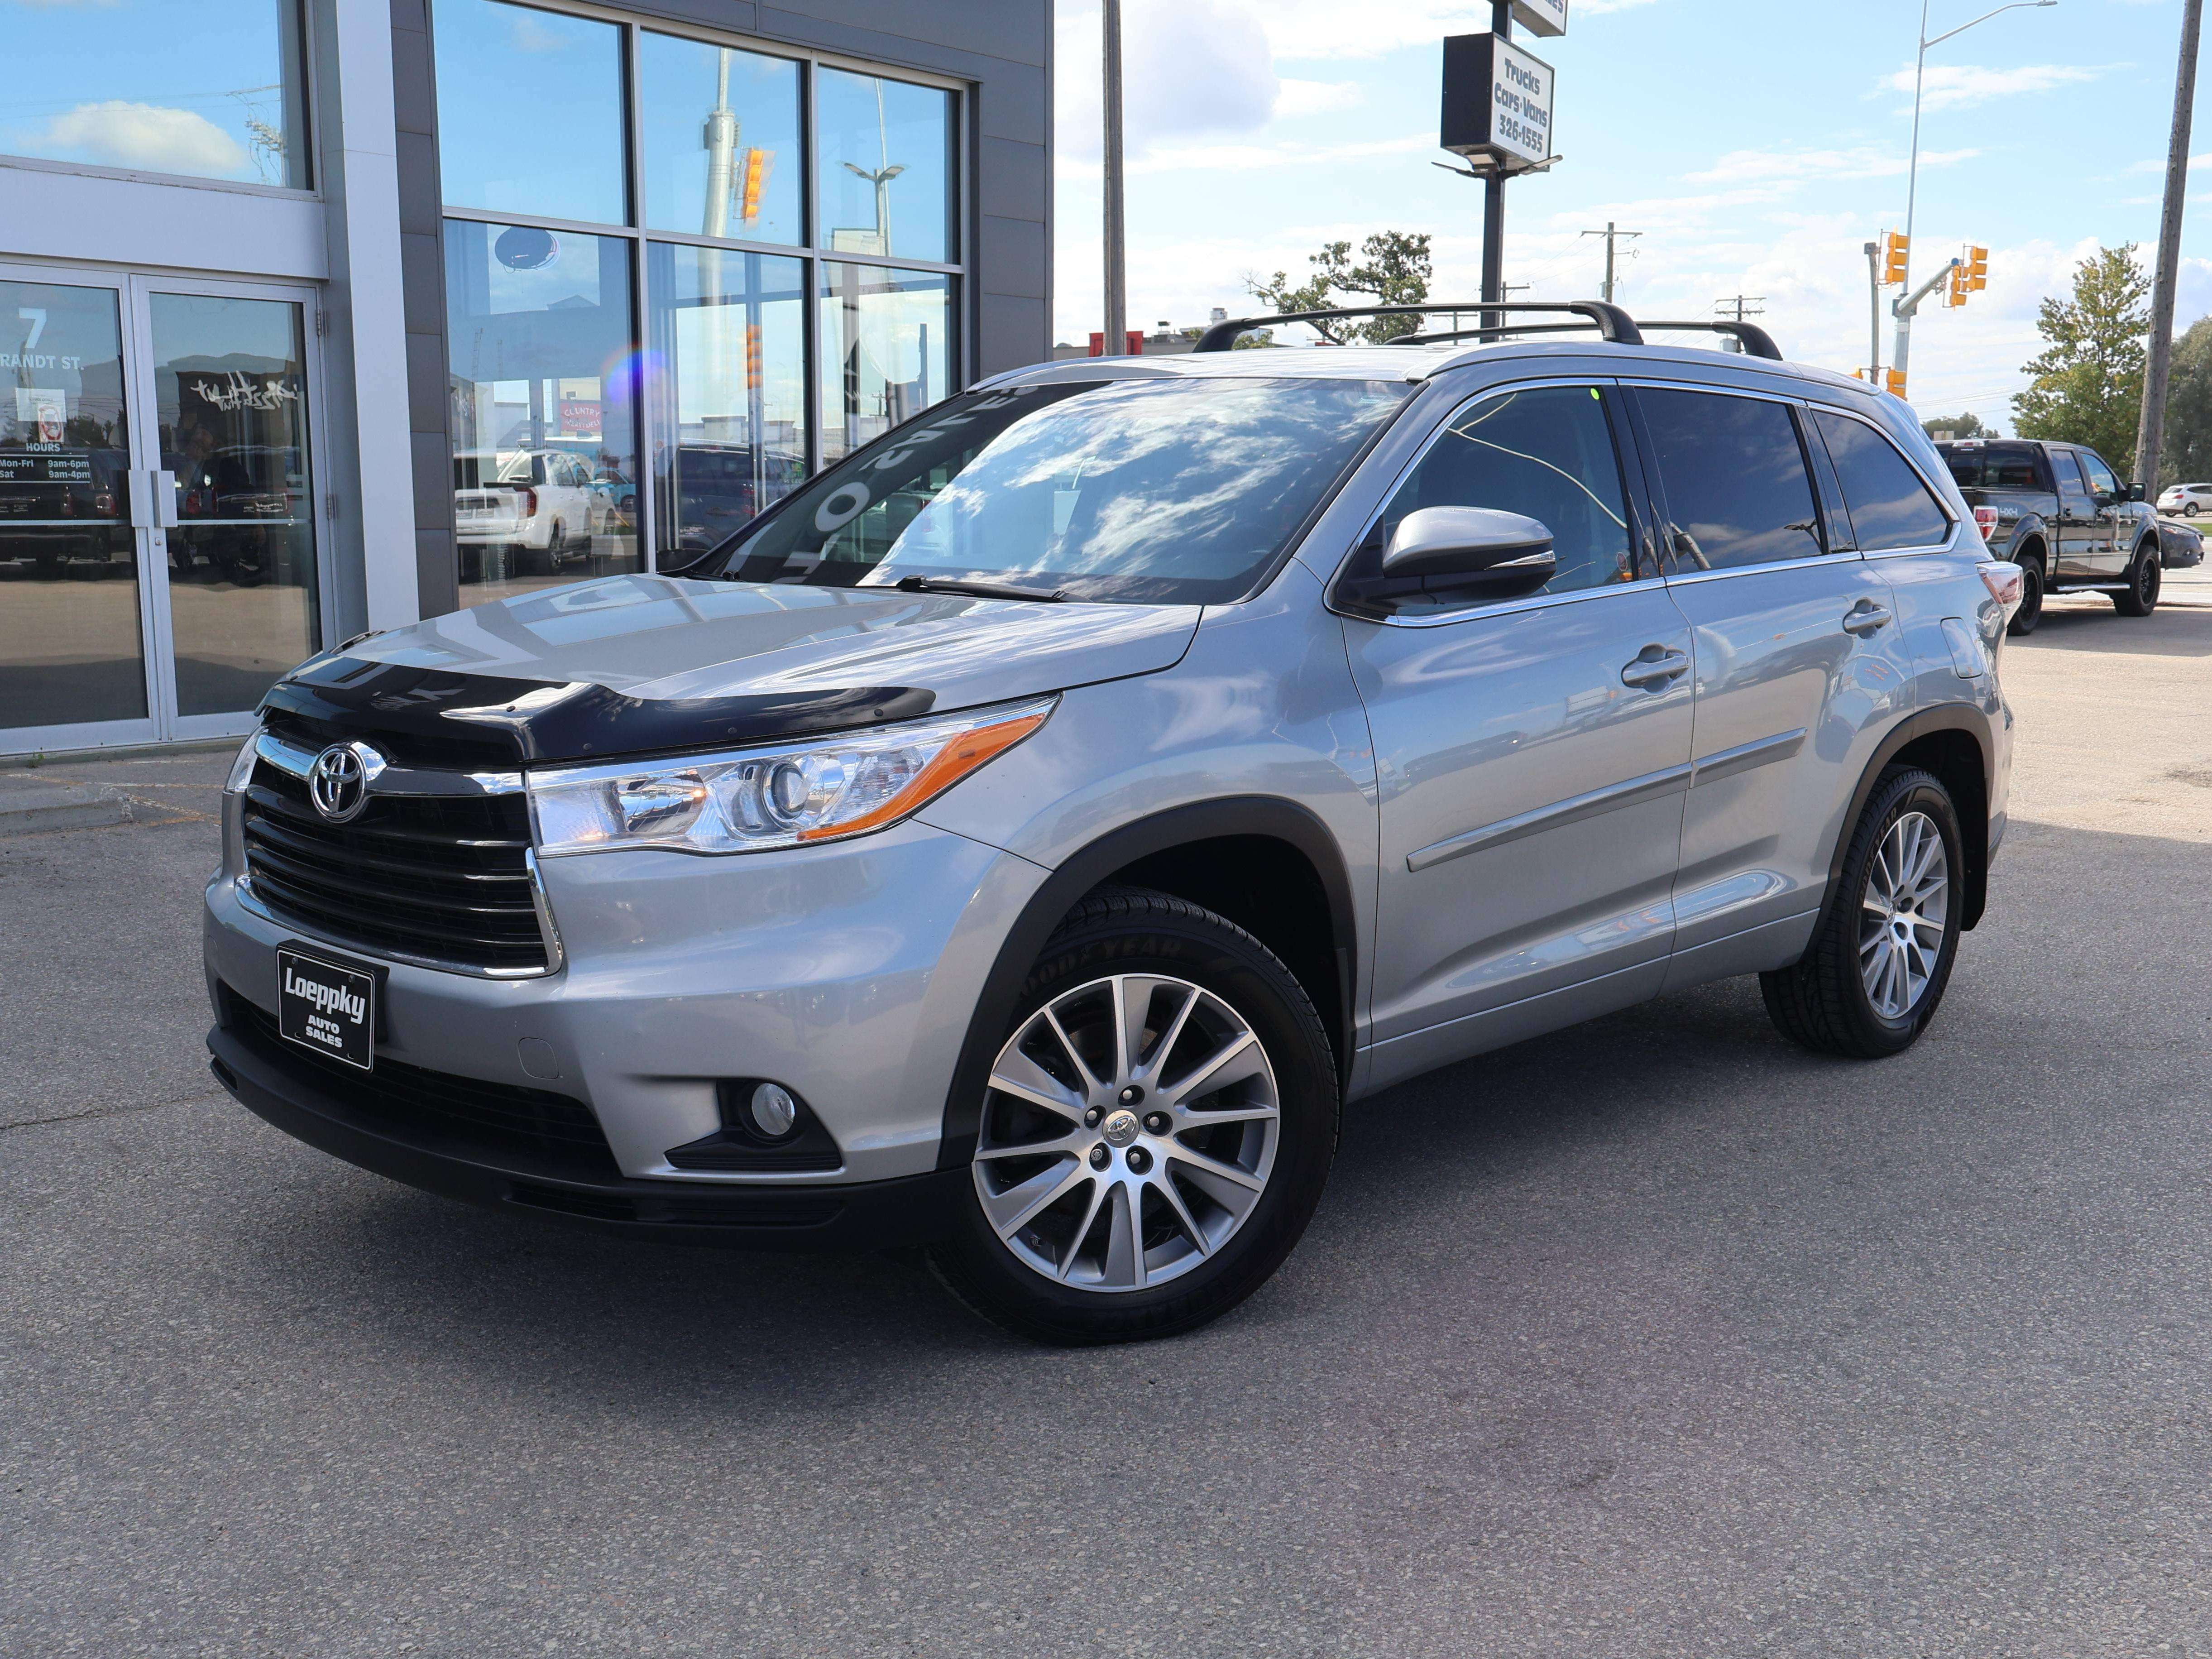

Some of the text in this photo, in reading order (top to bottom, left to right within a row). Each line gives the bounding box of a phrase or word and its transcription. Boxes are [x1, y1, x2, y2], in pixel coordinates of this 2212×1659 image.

[1504, 57, 1540, 96] Trucks
[1499, 114, 1543, 153] 326-1555
[19, 307, 47, 349] 7
[61, 356, 85, 370] ST.
[26, 443, 61, 452] HOURS
[48, 460, 90, 469] 9am-6pm
[48, 470, 91, 479] 9am-4pm
[285, 967, 366, 1024] Loeppky
[308, 1014, 340, 1034] AUTO
[306, 1026, 343, 1048] SALES
